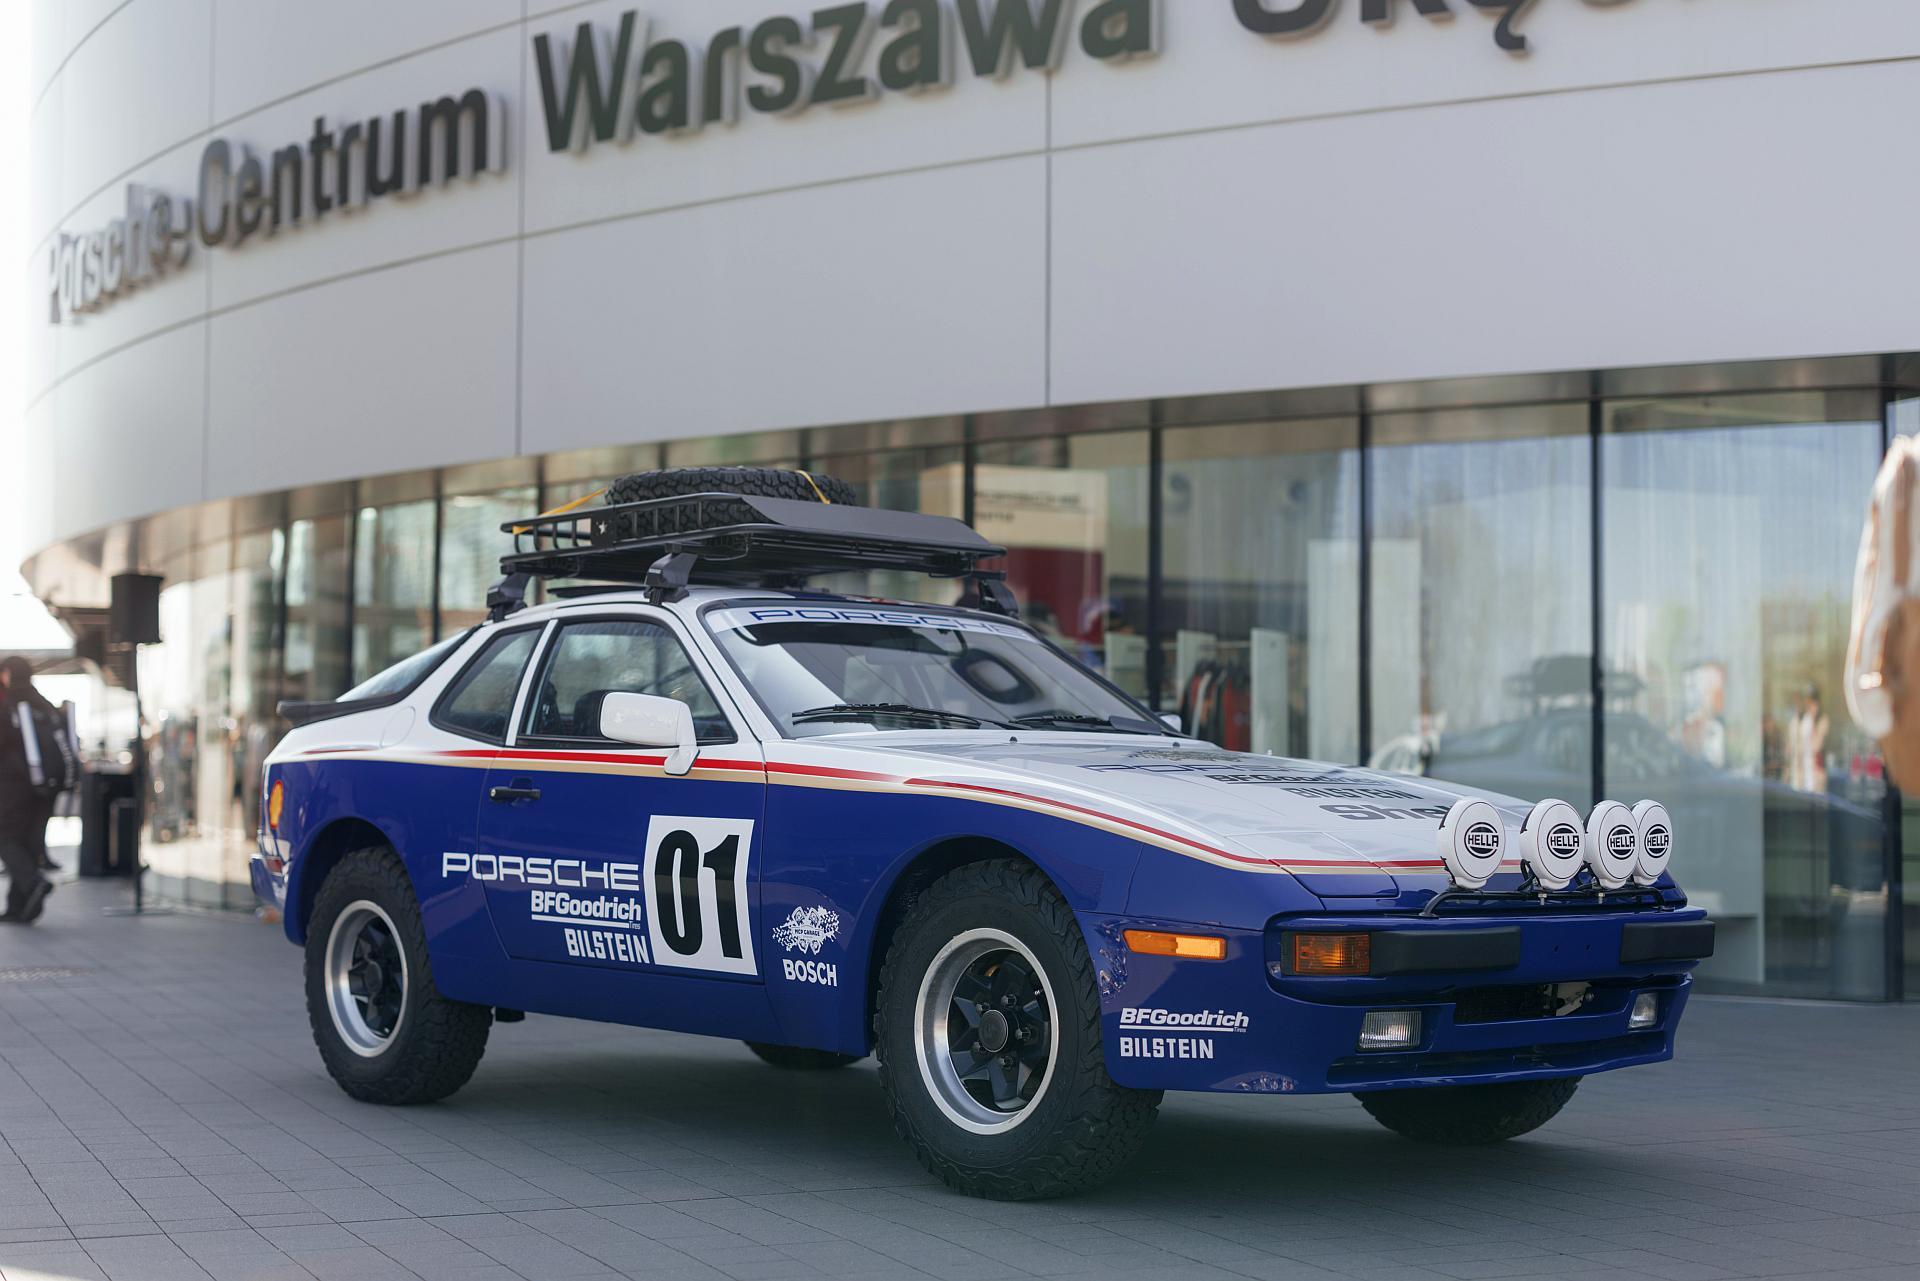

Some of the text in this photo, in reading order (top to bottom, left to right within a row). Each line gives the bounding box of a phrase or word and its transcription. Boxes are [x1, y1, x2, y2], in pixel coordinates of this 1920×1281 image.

[198, 88, 498, 248] Centrum
[533, 0, 1155, 153] Warszawa
[750, 608, 1022, 637] PORSCHE
[1281, 787, 1425, 800] BILSTEIN
[1468, 834, 1499, 848] HELLA
[1550, 834, 1579, 848] HELLA
[1609, 835, 1635, 848] HELLA
[1647, 834, 1669, 847] HELLA
[442, 852, 640, 891] PORSCHE
[532, 890, 641, 921] BFGoodrich
[655, 829, 741, 959] 01
[564, 928, 650, 963] BILSTEIN
[782, 959, 838, 986] BOSCH
[1120, 1008, 1249, 1028] BFGoodrich
[1120, 1037, 1214, 1059] BILSTEIN
